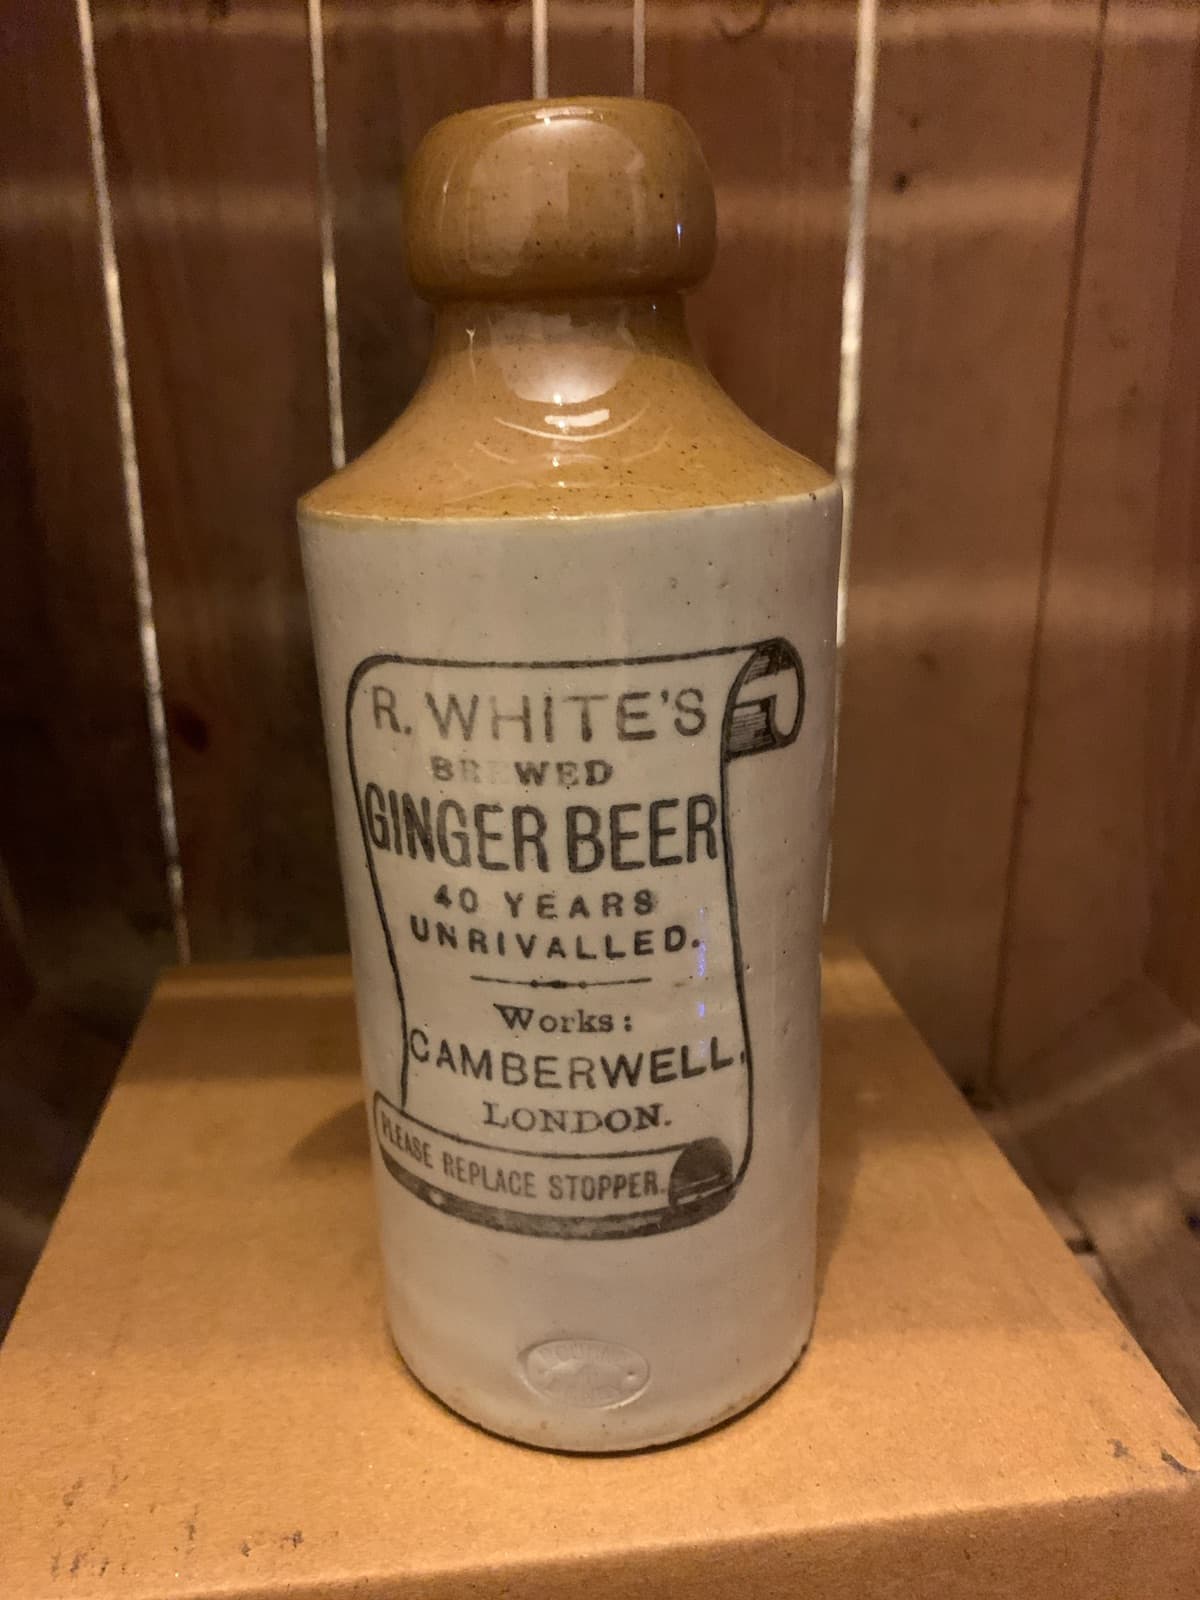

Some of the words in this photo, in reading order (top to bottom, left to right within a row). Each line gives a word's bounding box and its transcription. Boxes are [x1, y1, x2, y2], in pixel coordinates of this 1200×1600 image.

[372, 686, 412, 735] R.
[425, 688, 707, 742] WHITE'S
[364, 783, 549, 872] GINGER
[566, 794, 717, 873] BEER
[433, 884, 478, 914] 40
[503, 888, 656, 919] YEARS
[410, 914, 702, 959] UNRIVALLED.
[410, 1028, 746, 1089] CAMBERWELL.
[482, 1101, 673, 1134] LONDON.
[380, 1110, 434, 1169] PLEASE
[443, 1151, 535, 1198] REPLACE
[548, 1170, 666, 1201] STOPPER.
